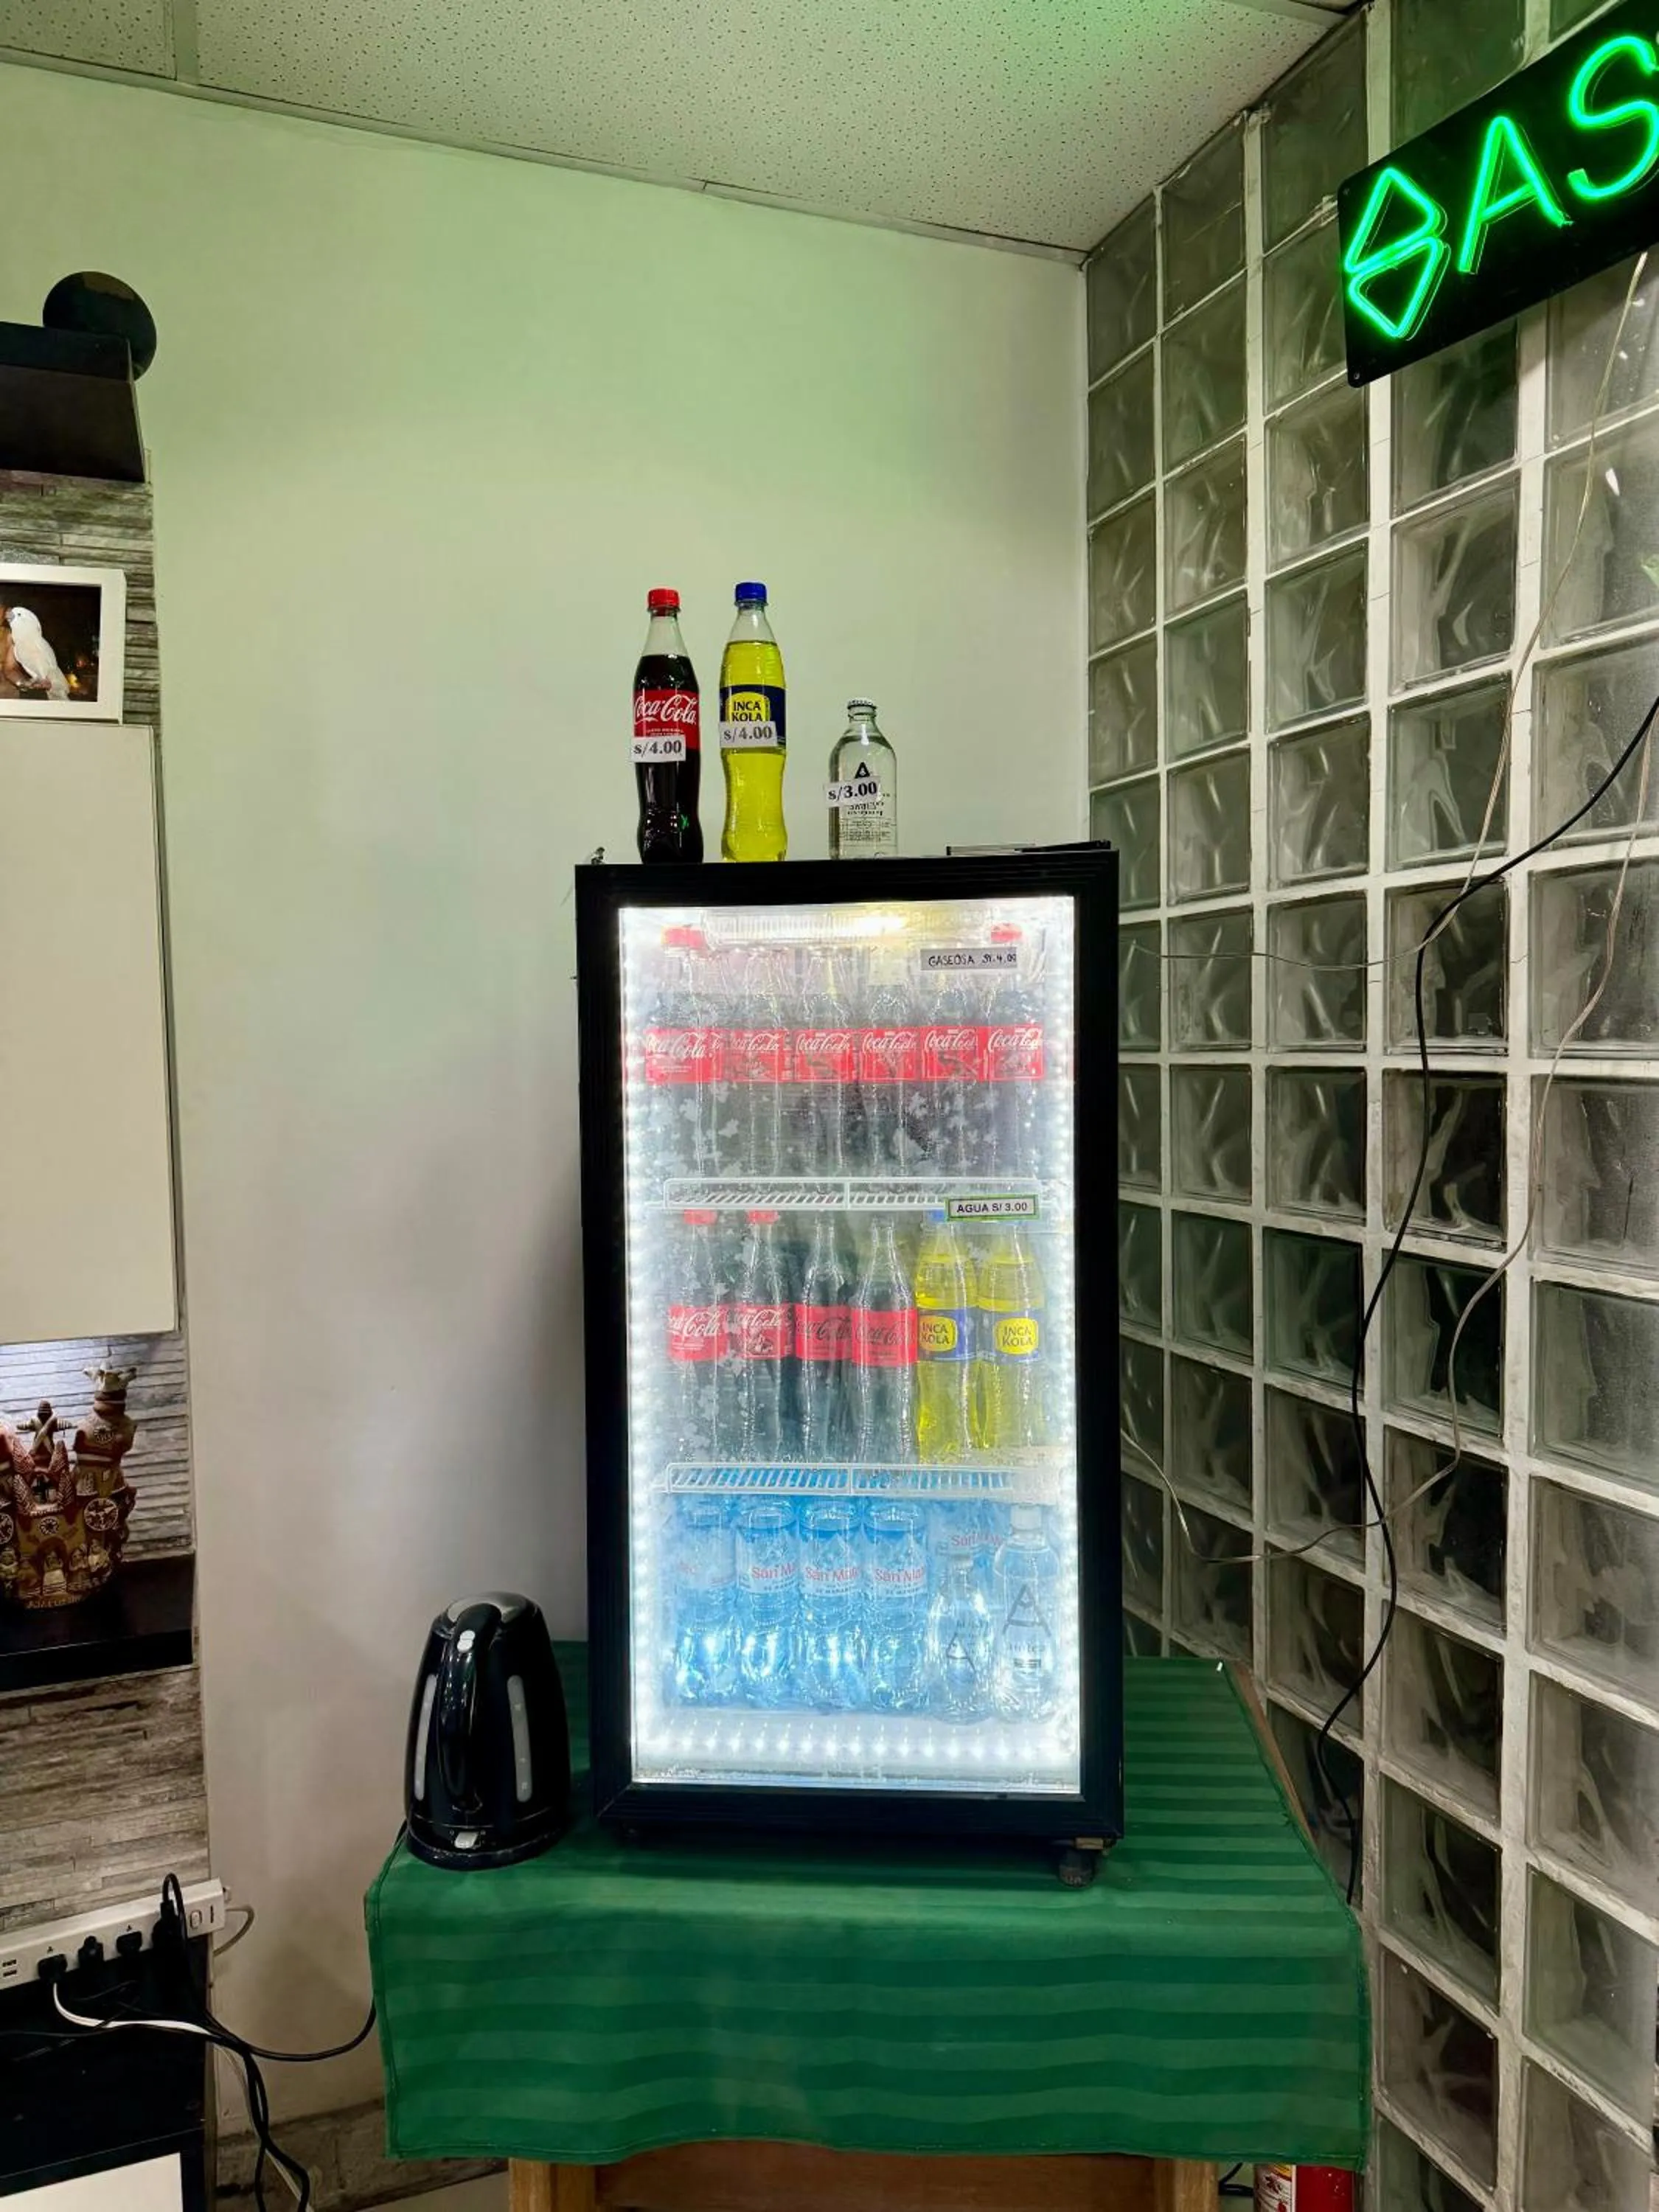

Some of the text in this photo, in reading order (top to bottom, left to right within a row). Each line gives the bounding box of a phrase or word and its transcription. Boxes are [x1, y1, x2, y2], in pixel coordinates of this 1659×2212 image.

[634, 694, 697, 724] Coca-Cola
[733, 700, 761, 712] INCA
[731, 712, 763, 722] KOLA
[724, 726, 773, 742] s/4.00
[633, 740, 682, 758] s/4.00
[828, 782, 877, 801] s/3.00
[928, 953, 975, 967] GASEOSA
[956, 1203, 989, 1213] AGUA
[922, 1322, 949, 1334] INCA
[1004, 1326, 1032, 1335] INCA
[921, 1334, 950, 1345] KOLA
[1002, 1335, 1034, 1347] KOLA
